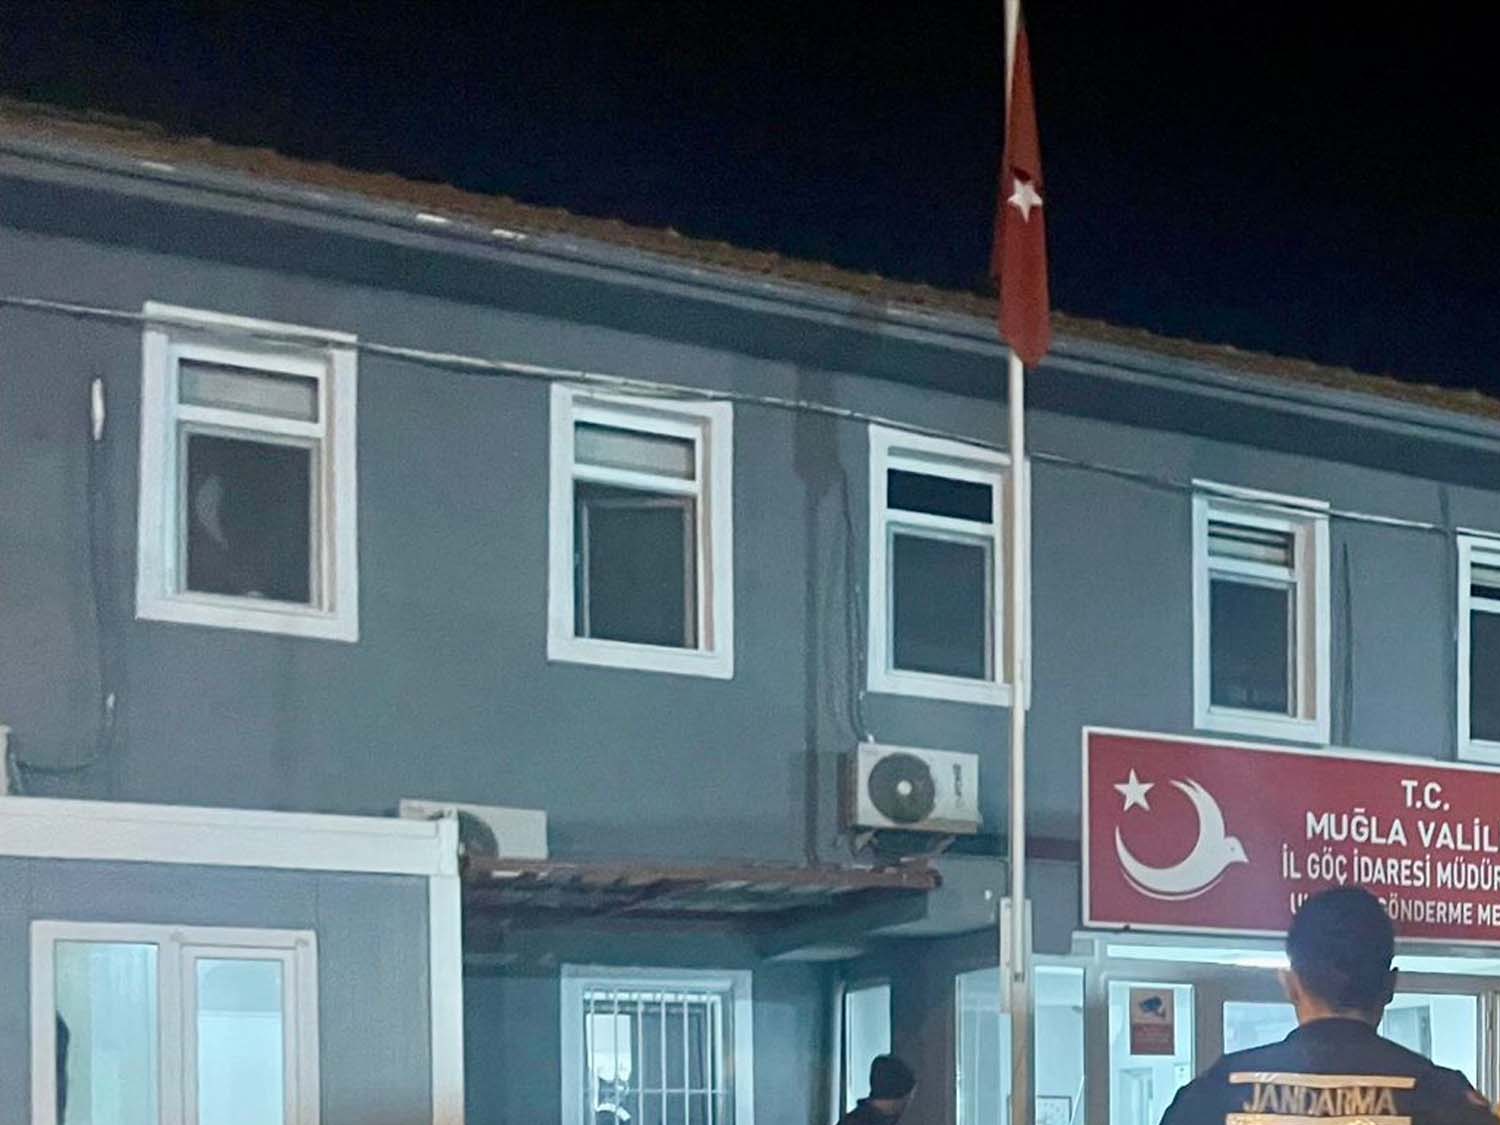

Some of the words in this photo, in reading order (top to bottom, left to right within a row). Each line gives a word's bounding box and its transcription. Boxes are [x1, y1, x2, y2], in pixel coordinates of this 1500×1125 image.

[1401, 779, 1450, 811] T.C.
[1306, 807, 1407, 847] MUĞLA
[1282, 843, 1301, 879] İL
[1307, 846, 1347, 886] GÖÇ
[1353, 848, 1431, 889] İDARESİ
[1377, 892, 1473, 925] ÖNDERME
[1242, 1082, 1398, 1117] JANDARMA
